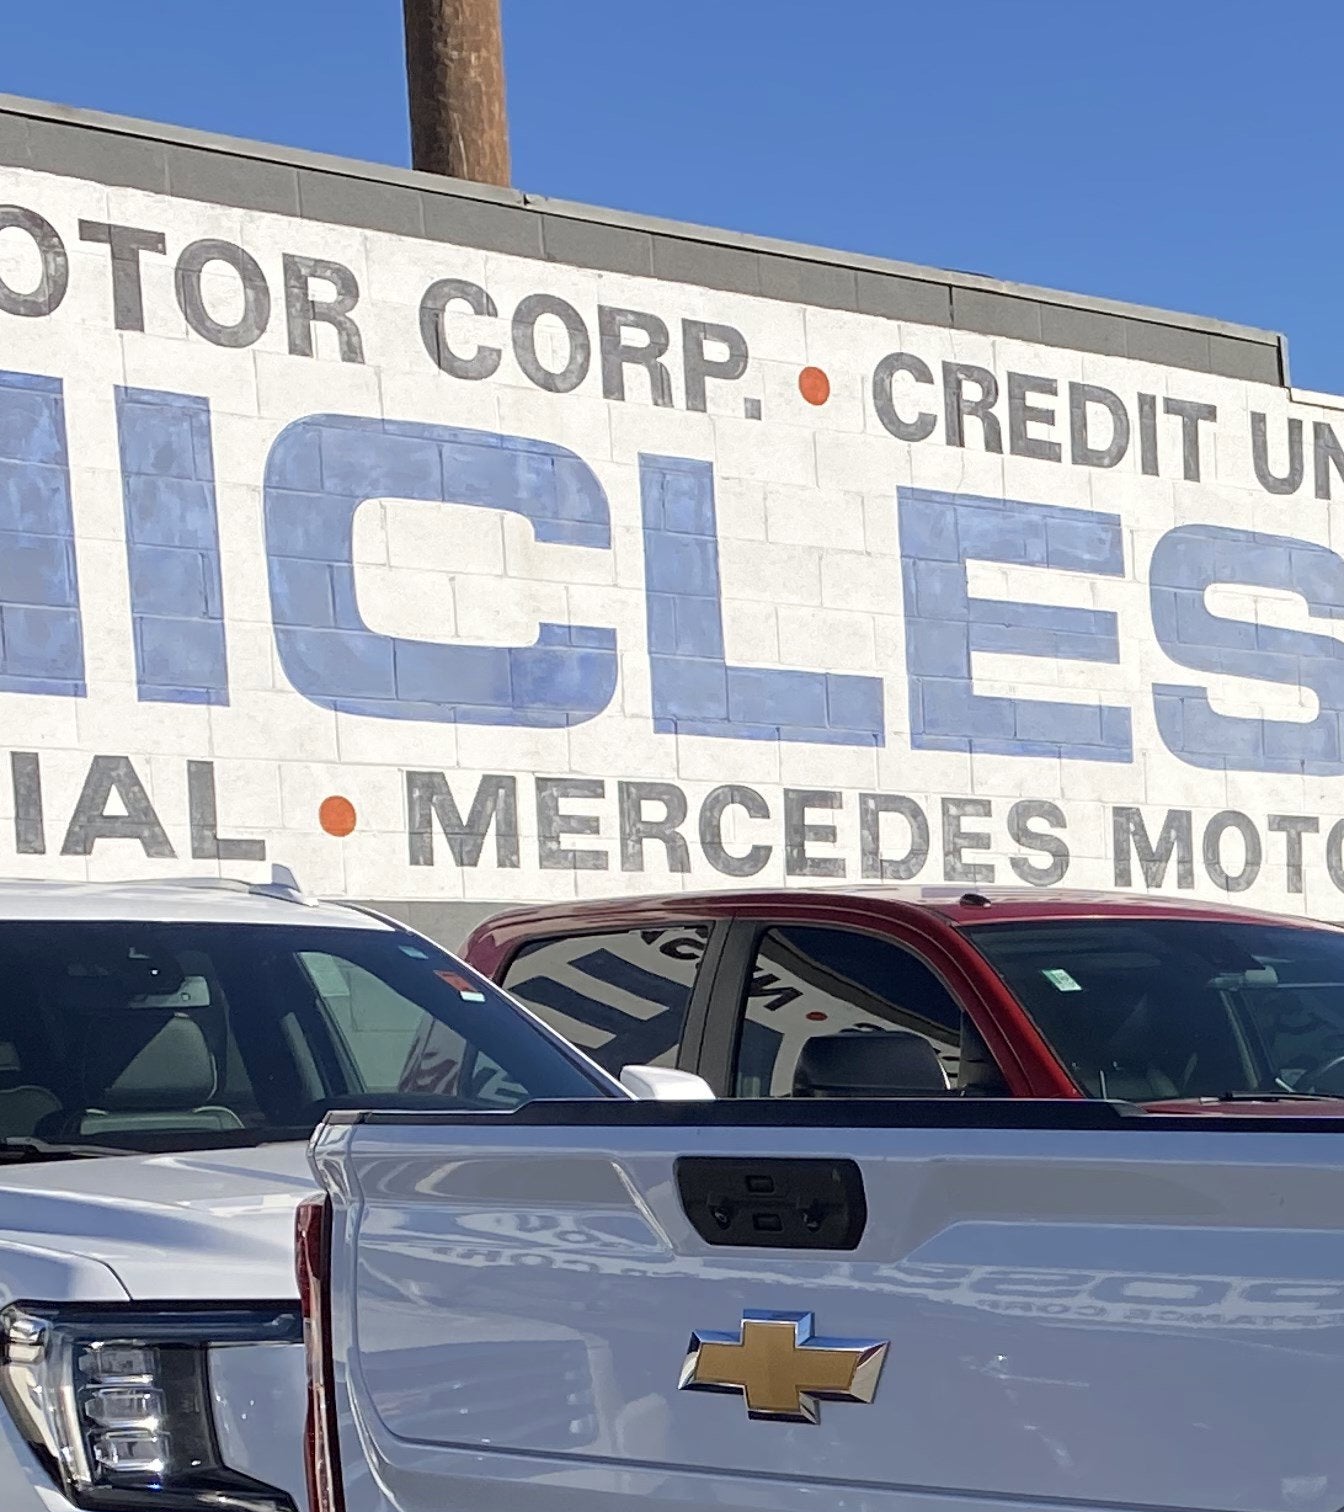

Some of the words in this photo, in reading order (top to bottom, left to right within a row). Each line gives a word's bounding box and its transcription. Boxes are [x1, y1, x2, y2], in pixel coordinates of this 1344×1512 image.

[419, 277, 762, 420] CORP.
[872, 353, 1216, 482] CREDIT
[406, 768, 1070, 887] MERCEDES
